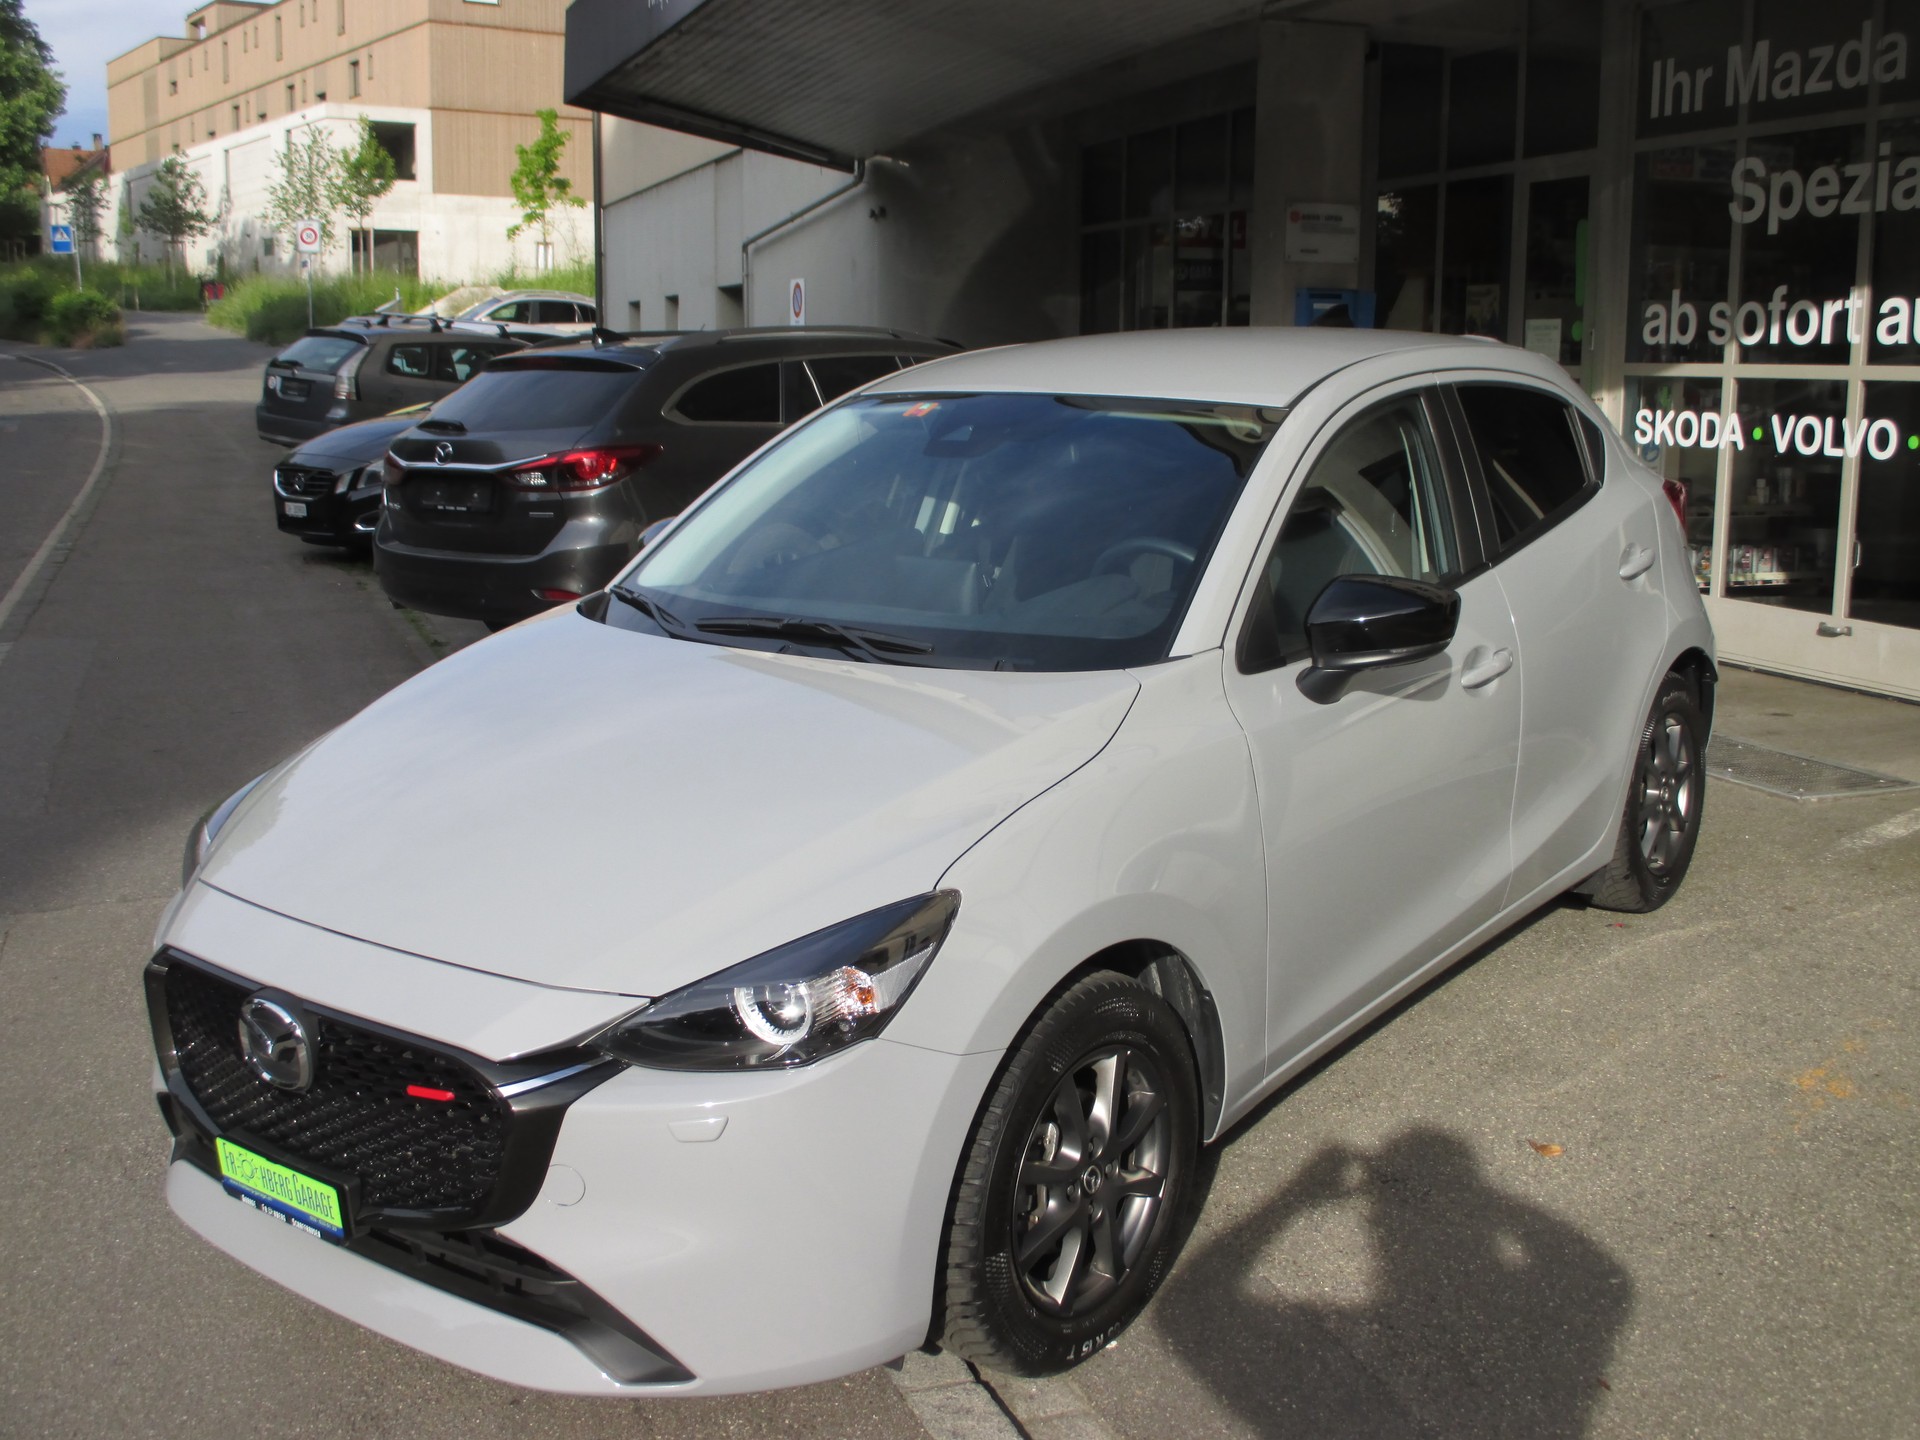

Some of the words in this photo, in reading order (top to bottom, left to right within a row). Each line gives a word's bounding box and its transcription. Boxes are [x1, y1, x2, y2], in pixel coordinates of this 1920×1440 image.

[1650, 58, 1713, 119] Ihr
[1724, 20, 1908, 107] Mazda
[1642, 290, 1698, 346] ab
[1708, 285, 1863, 346] sofort
[1634, 409, 1745, 451] SKODA
[1771, 415, 1898, 461] VOLVO
[292, 1173, 335, 1220] GARAGE
